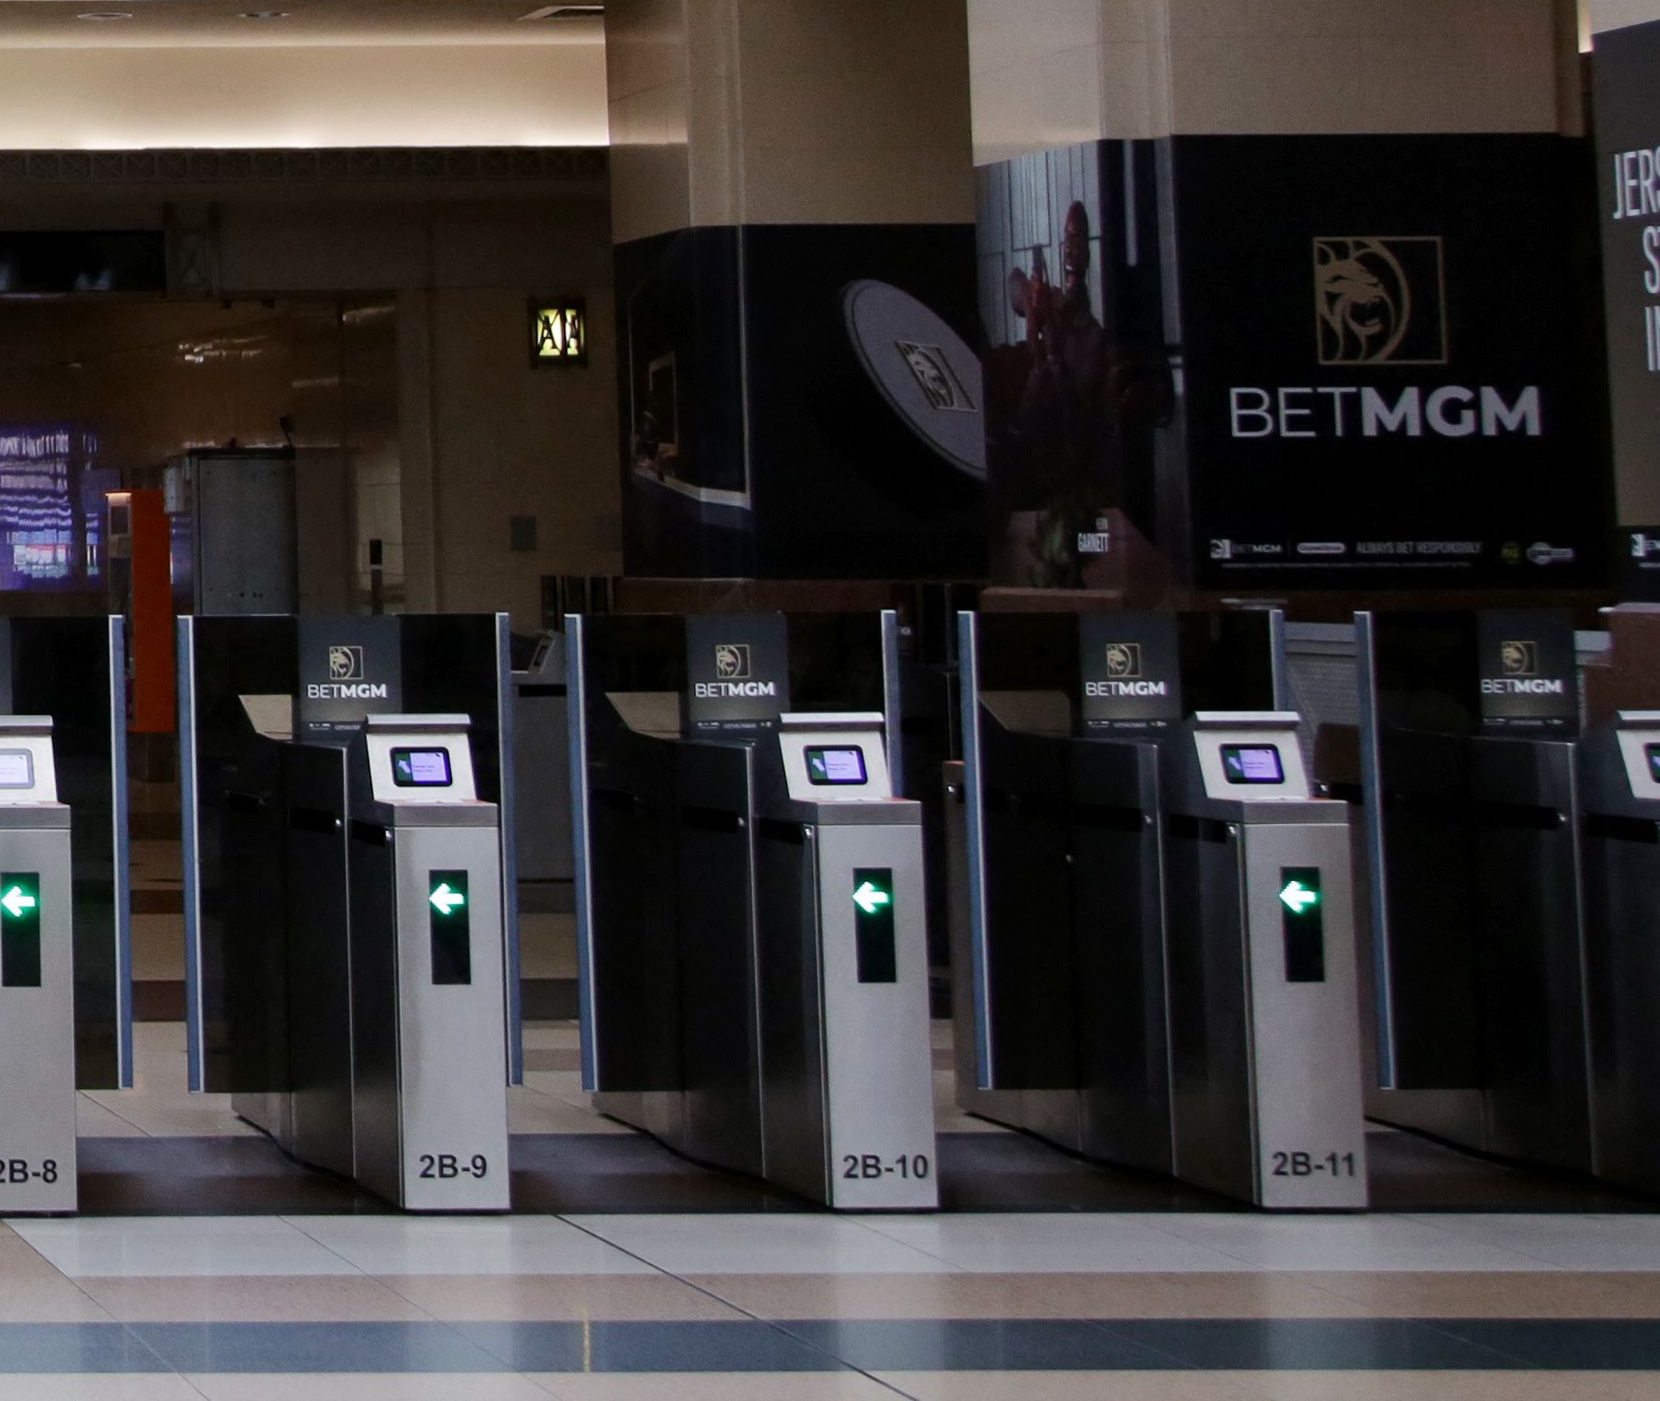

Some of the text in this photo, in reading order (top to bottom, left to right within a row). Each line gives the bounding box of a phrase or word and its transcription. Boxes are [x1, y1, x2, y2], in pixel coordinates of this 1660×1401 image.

[1230, 385, 1542, 438] BETMGM
[307, 682, 388, 699] BETMGM
[695, 681, 775, 698] BETMGM
[1085, 679, 1166, 696] BETMGM
[1481, 677, 1563, 694] BETMGM
[419, 1154, 487, 1179] 2B-9
[843, 1154, 929, 1180] 2B-10
[1273, 1151, 1355, 1177] 2B-11
